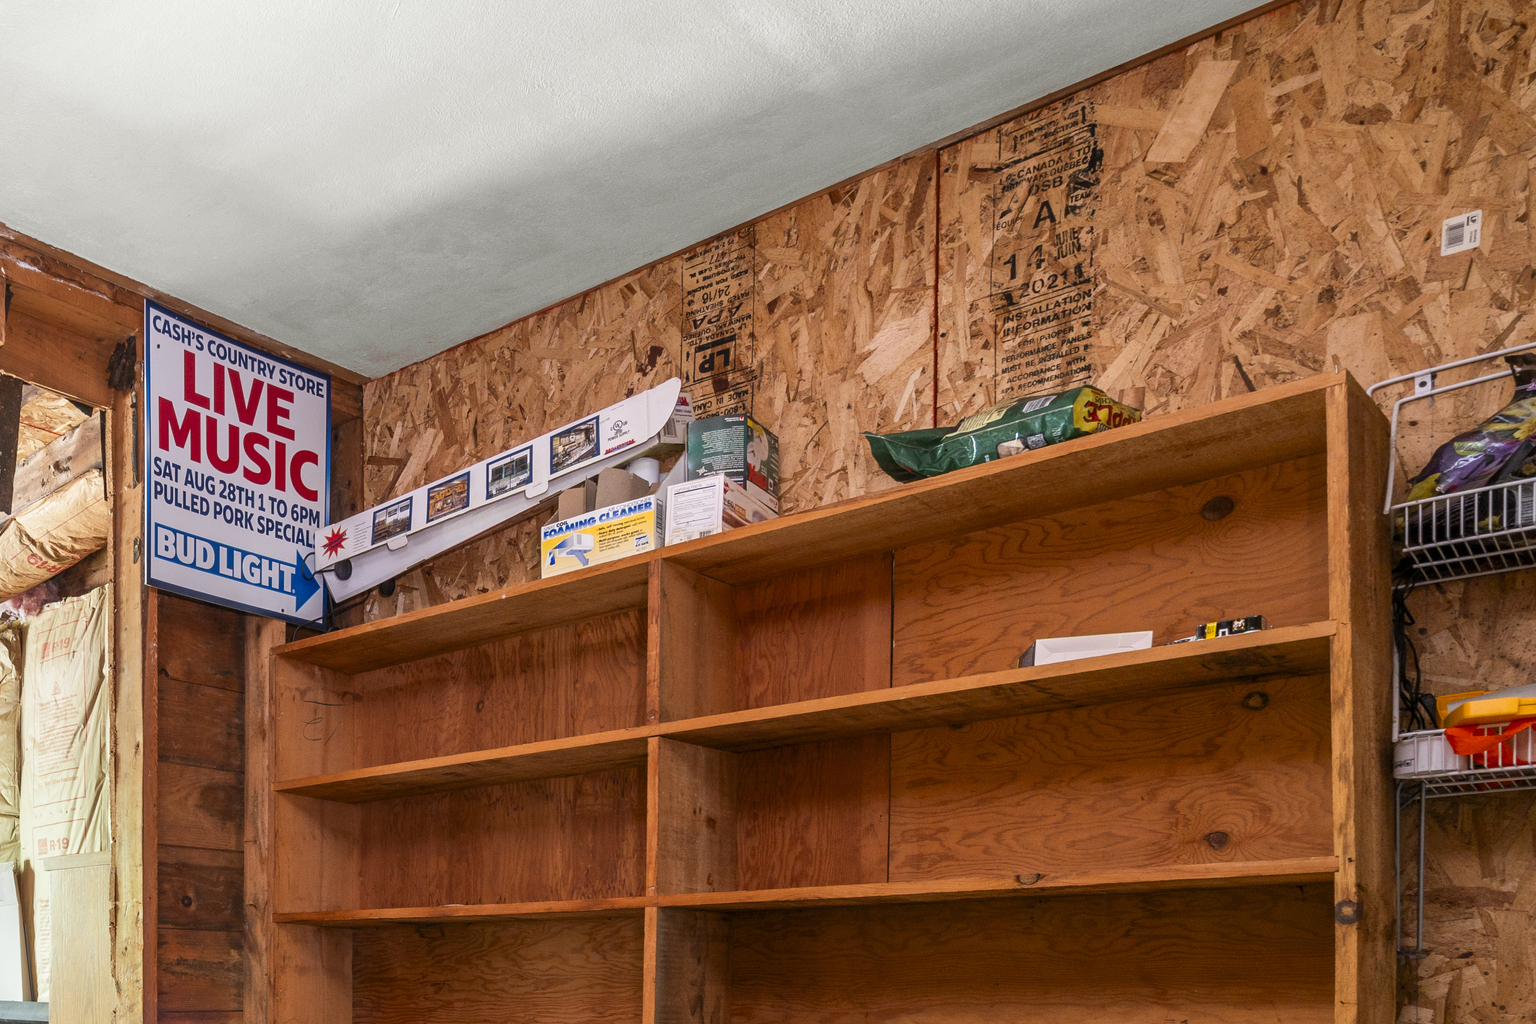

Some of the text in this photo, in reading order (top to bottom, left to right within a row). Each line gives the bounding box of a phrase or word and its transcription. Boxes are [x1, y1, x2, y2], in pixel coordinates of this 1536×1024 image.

[1017, 156, 1063, 178] CANADA
[1069, 145, 1091, 160] LTD
[1029, 176, 1063, 195] OSB
[1033, 200, 1056, 230] A
[1054, 239, 1081, 260] JUIN
[716, 277, 728, 286] FOR
[702, 285, 731, 304] 24/16
[1003, 288, 1092, 325] INSTALLATION
[686, 300, 724, 318] SHEATHING
[692, 302, 744, 330] APA
[1003, 301, 1092, 337] INFORMATION
[705, 328, 735, 342] CANADA
[1040, 326, 1075, 342] PROPER
[152, 315, 325, 398] CASH'S COUNTRY STORE
[1001, 331, 1093, 364] PERFORMANCE PANELS
[699, 348, 730, 374] LP
[1001, 363, 1022, 375] MUST
[1007, 356, 1086, 384] ACCORDANCE WITH
[1017, 364, 1092, 391] RECOMMENDATIONS
[184, 349, 295, 441] LIVE
[693, 400, 712, 413] CANA
[716, 396, 724, 406] IN
[728, 389, 749, 402] MADE
[158, 395, 319, 502] MUSIC
[153, 457, 320, 528] SAT AUG 28TH 1 TO 6PM
[615, 496, 652, 510] CONDITIONER
[153, 480, 210, 516] PULLED
[214, 501, 254, 531] PORK
[257, 515, 315, 549] SPECIAL
[543, 516, 597, 541] FOAMING
[598, 501, 653, 523] CLEANER
[556, 520, 569, 528] COIL
[26, 552, 62, 574] R-19
[156, 526, 296, 594] BUD LIGHT
[51, 636, 72, 653] R-19
[49, 837, 70, 852] R-19
